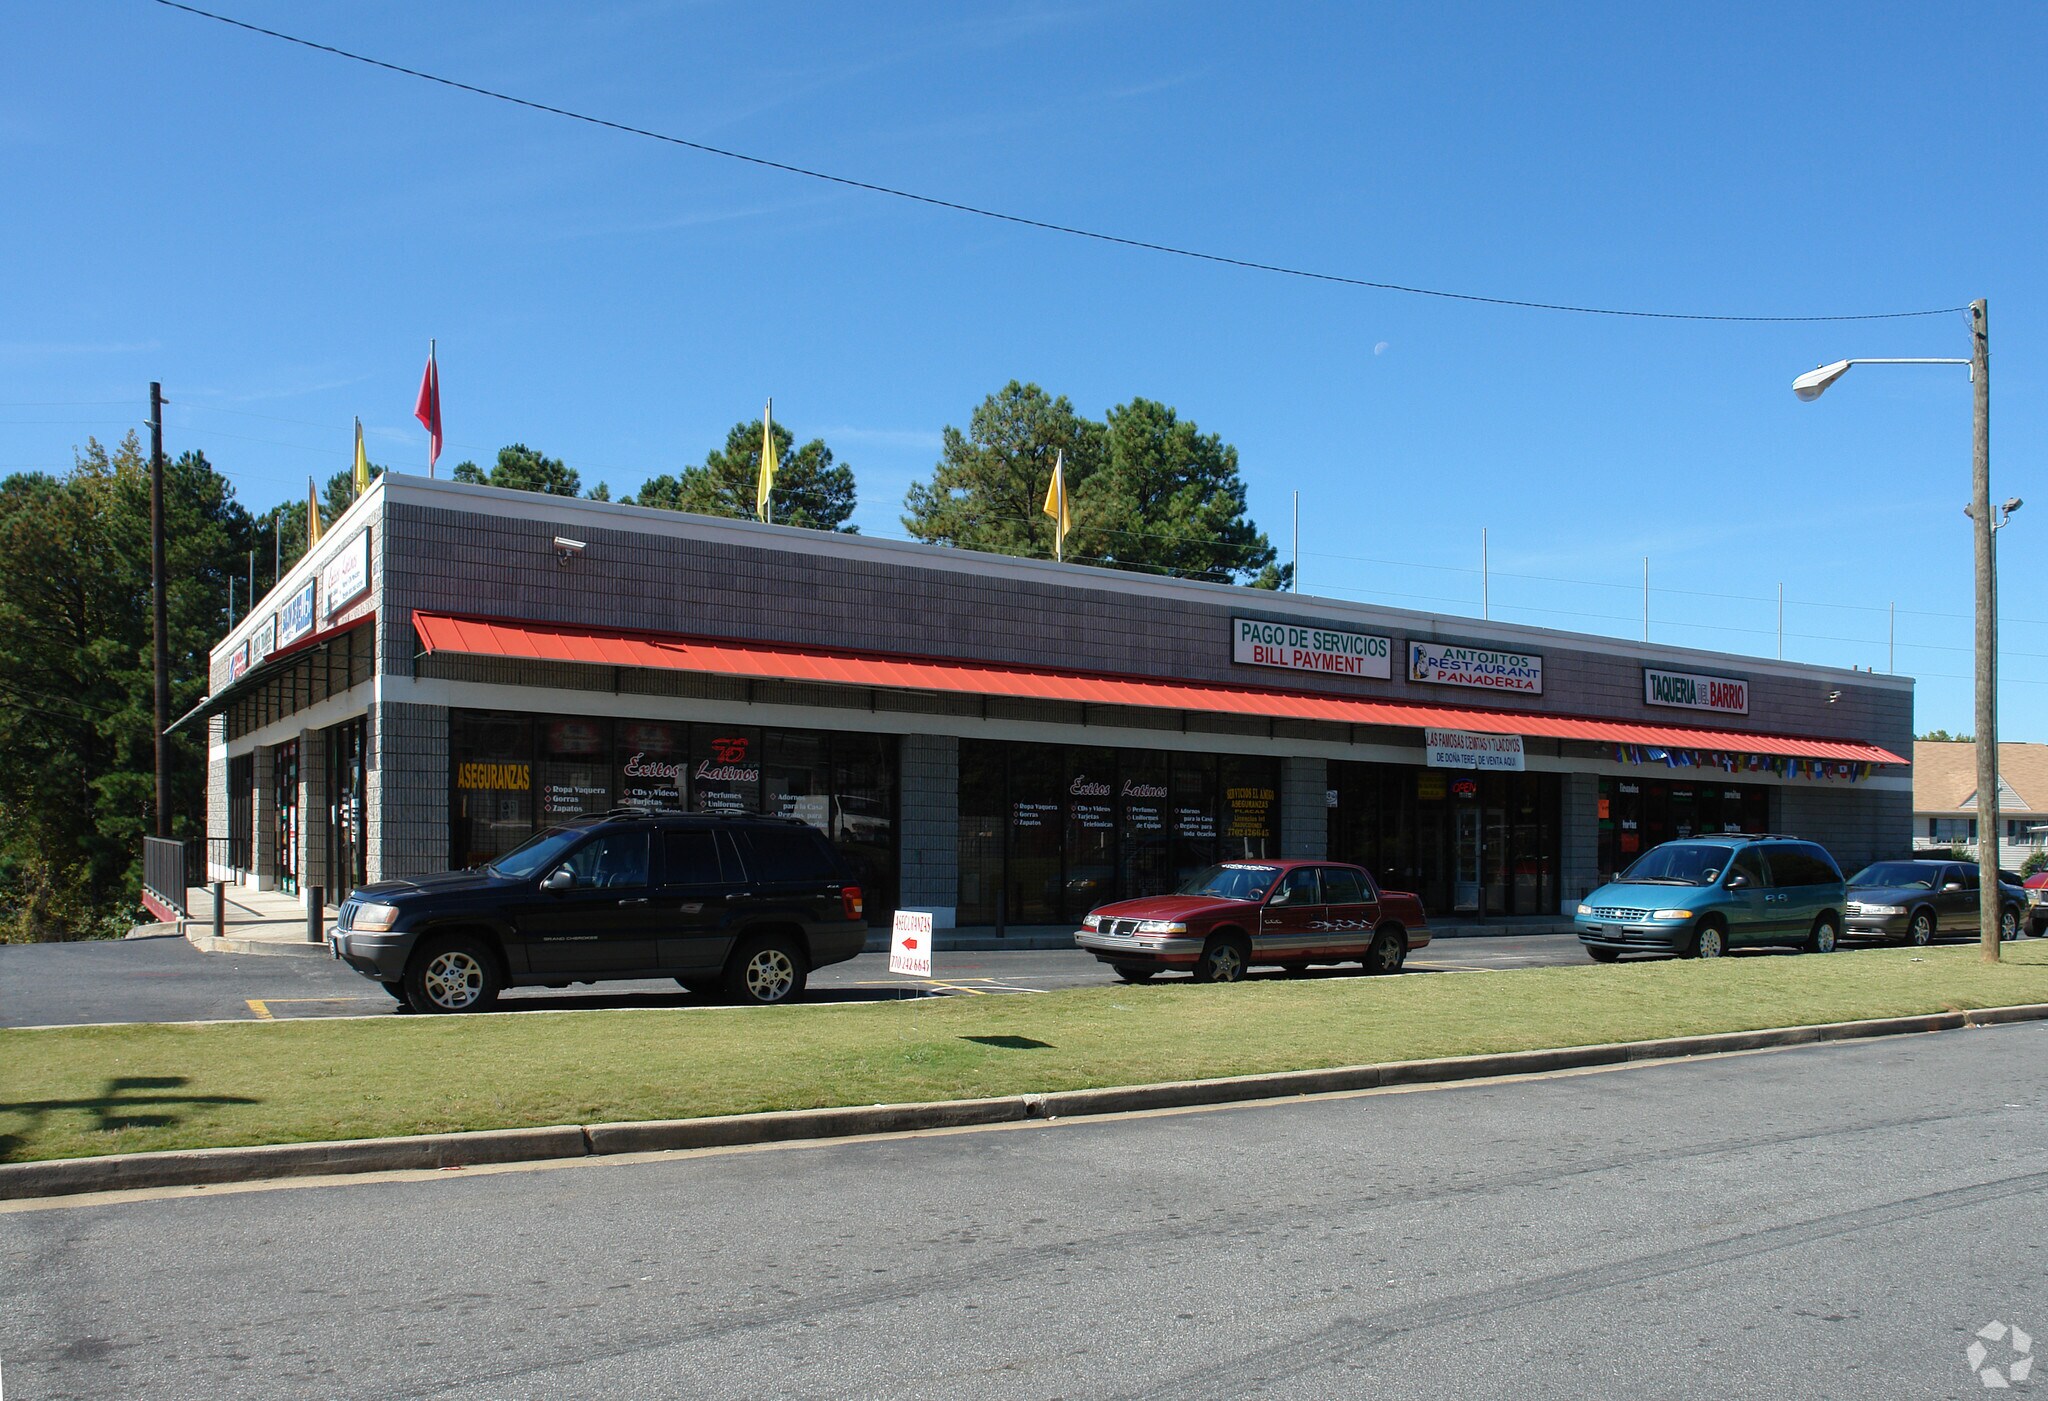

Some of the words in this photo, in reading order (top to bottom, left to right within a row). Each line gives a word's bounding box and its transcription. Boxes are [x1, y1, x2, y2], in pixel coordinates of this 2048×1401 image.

[1242, 622, 1285, 645] PAGO
[1289, 628, 1308, 648] DE
[1313, 631, 1387, 657] SERVICIOS
[1254, 645, 1288, 666] BILL
[1293, 650, 1364, 673] PAYMENT
[1443, 648, 1528, 668] ANTOJITOS
[1428, 657, 1540, 679] RESTAURANT
[1437, 670, 1534, 690] PANADERIA
[1650, 674, 1697, 705] TAQUERIA
[1710, 681, 1744, 710] BARRIO
[1426, 732, 1438, 747] LAS
[1439, 733, 1464, 749] FAMOSAS
[1465, 736, 1487, 751] CEMITAS
[1487, 737, 1492, 752] Y
[1491, 738, 1520, 753] TLACOYOS
[1436, 752, 1444, 762] DE
[1445, 751, 1460, 763] DOÑA
[1461, 753, 1475, 764] TERE
[1478, 755, 1486, 765] DE
[1486, 755, 1502, 766] VENTA
[624, 752, 679, 778] Éxitos
[695, 759, 759, 782] Latinos
[457, 761, 530, 790] ASEGURANZAS
[553, 785, 572, 794] Ropa
[575, 786, 606, 795] Vaquera
[1070, 774, 1111, 796] Éxitos
[1121, 778, 1168, 798] Latinos
[1452, 782, 1478, 793] OPEN
[632, 788, 647, 796] CDs
[655, 789, 678, 797] Videos
[708, 791, 742, 799] Perfumes
[778, 793, 806, 801] Adornos
[1226, 788, 1252, 800] SERVICIOS
[1252, 788, 1258, 799] EL
[632, 798, 663, 807] Tarjetas
[708, 800, 744, 809] Uniformes
[1019, 802, 1034, 810] Ropa
[1035, 803, 1058, 811] Vaquera
[1231, 800, 1269, 808] ASEGURANZAS
[553, 805, 583, 813] Zapatos
[1143, 822, 1162, 830] Equipo
[1180, 822, 1199, 830] Regalos
[895, 915, 931, 933] ASEGURANZAS
